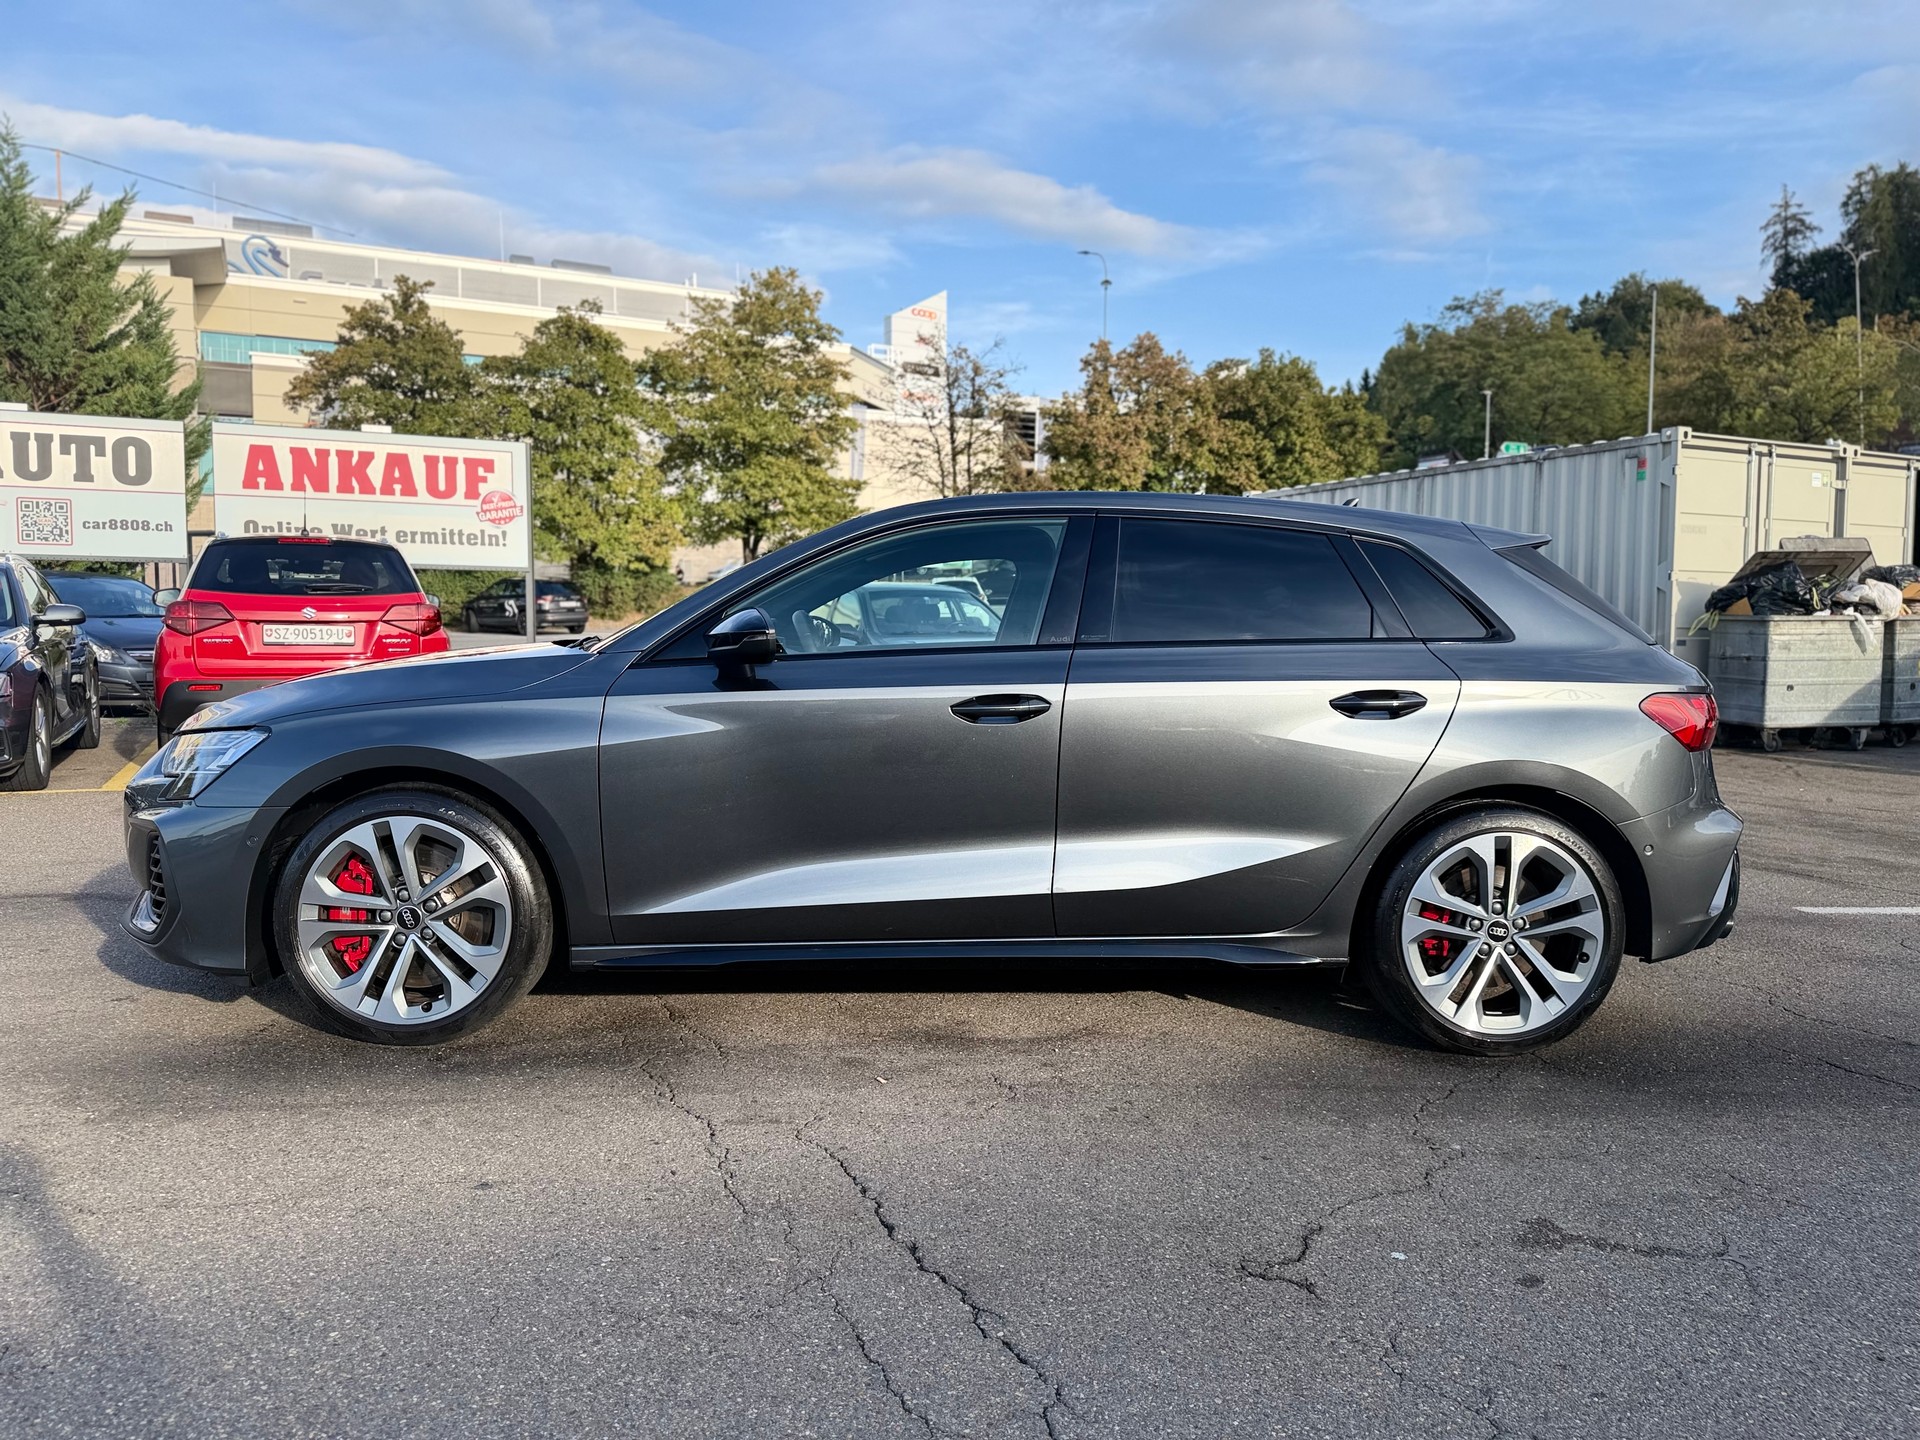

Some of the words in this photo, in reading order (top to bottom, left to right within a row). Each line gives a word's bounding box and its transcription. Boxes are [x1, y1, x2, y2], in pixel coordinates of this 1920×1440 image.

[0, 431, 153, 486] UTO
[242, 444, 495, 500] ANKAUF
[478, 507, 522, 521] GARANTIE
[82, 519, 174, 532] car8808.ch
[395, 527, 508, 547] ermitteln!
